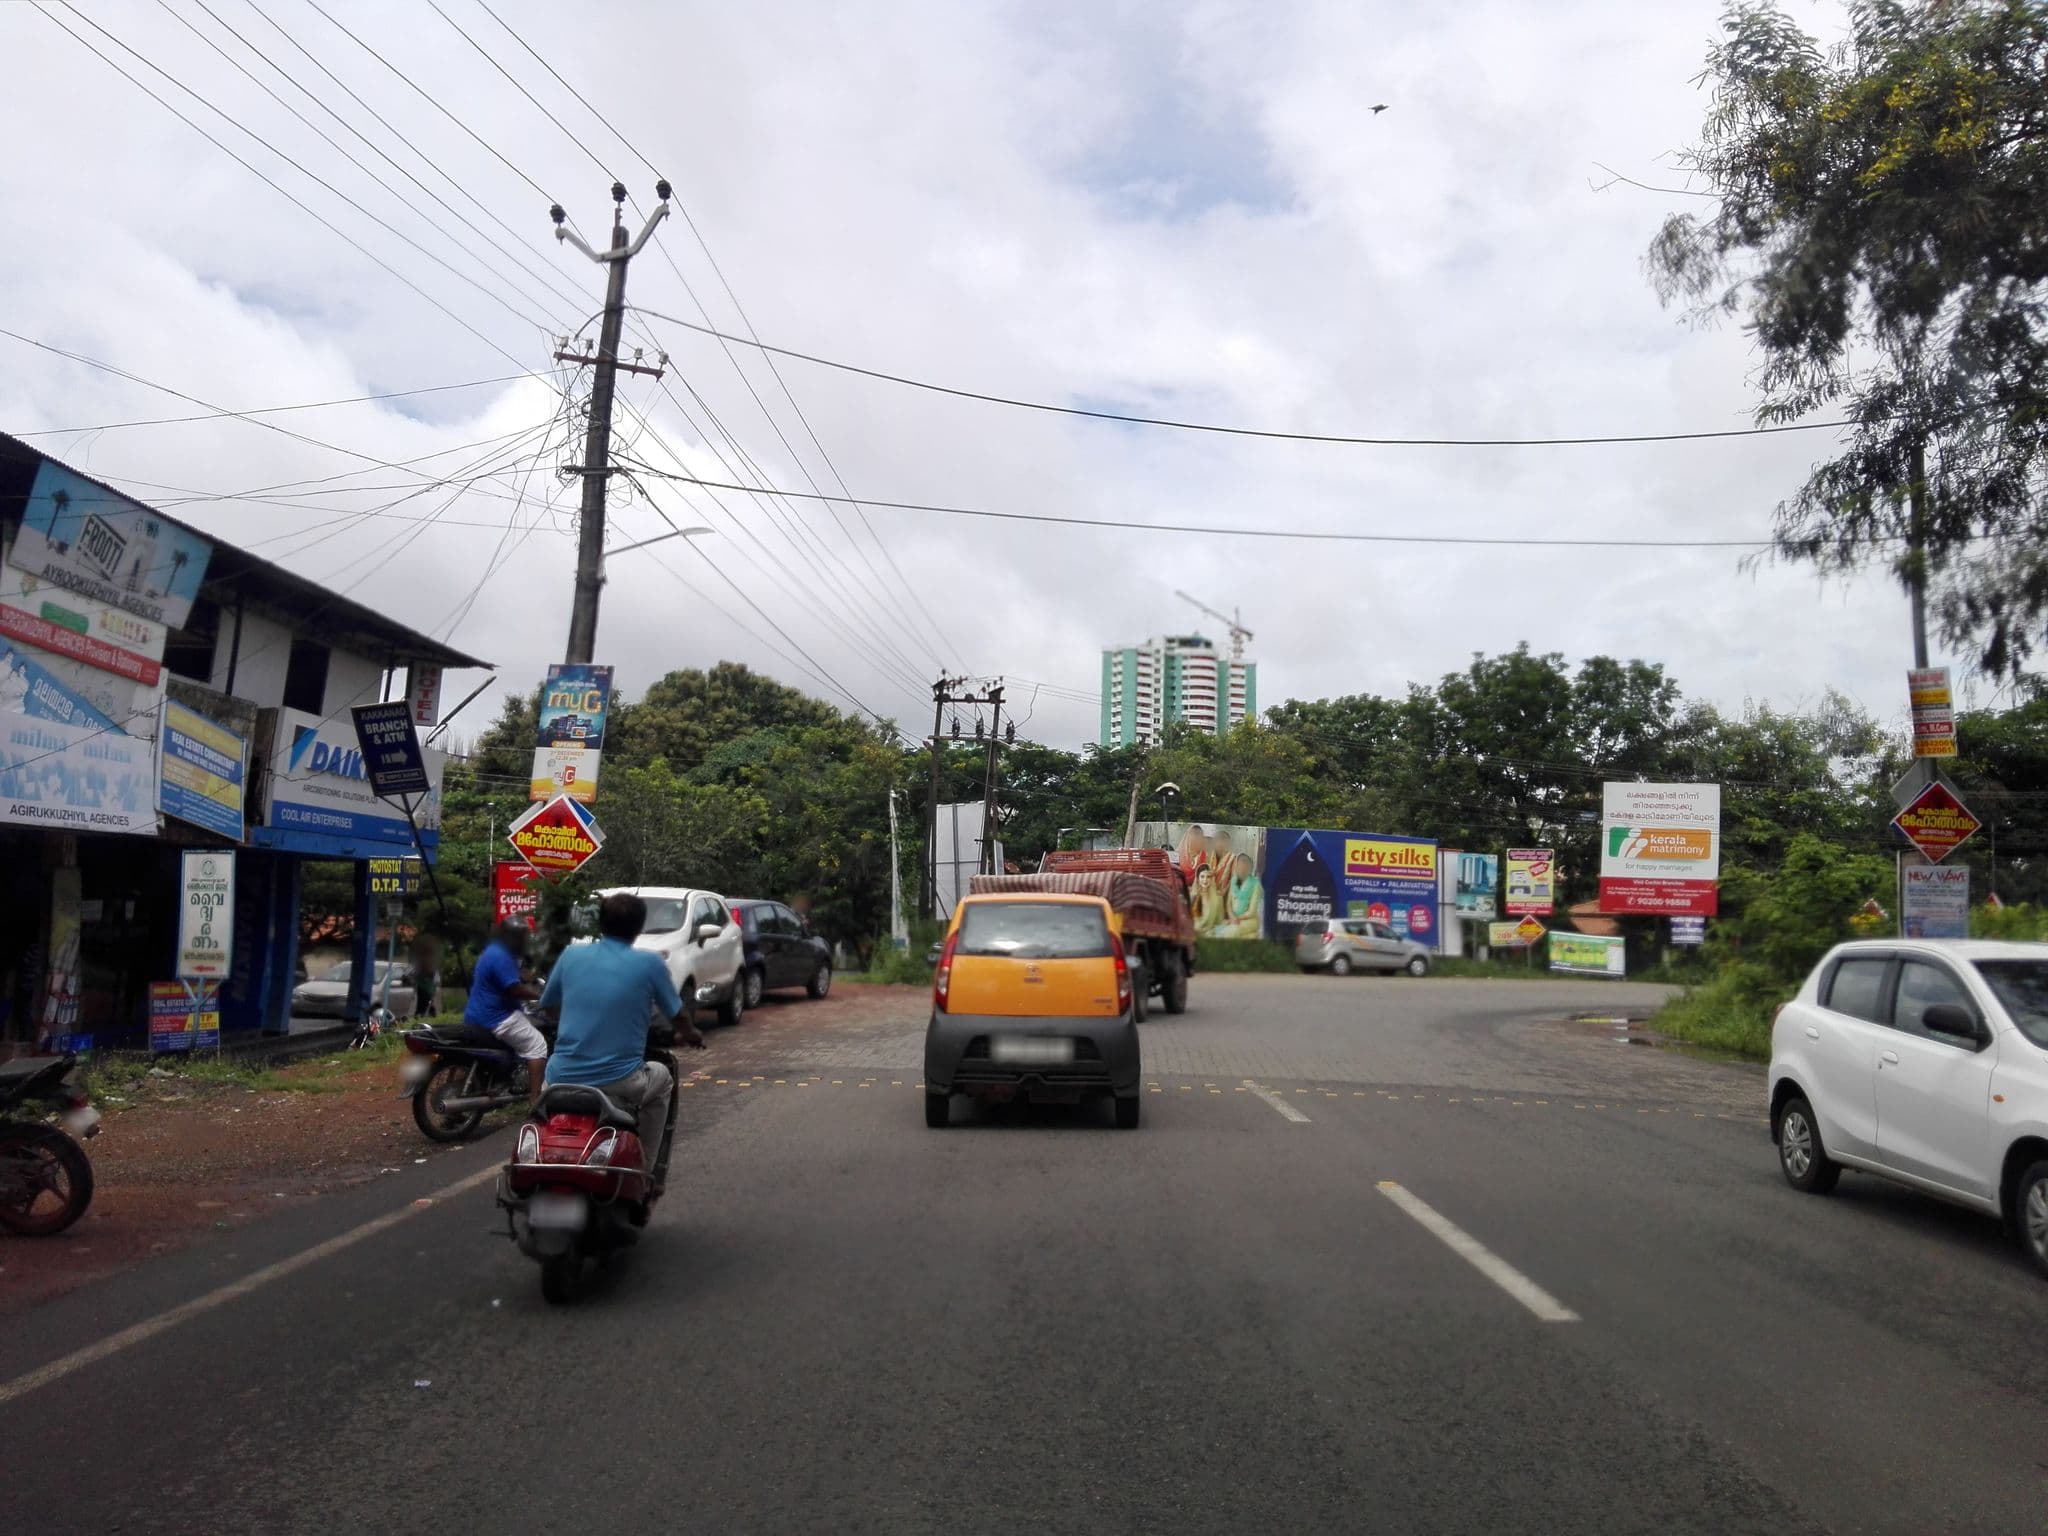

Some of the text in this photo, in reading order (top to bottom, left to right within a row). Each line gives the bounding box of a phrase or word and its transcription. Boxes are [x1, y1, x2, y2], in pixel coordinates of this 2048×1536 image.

[80, 517, 124, 574] FROOTI
[417, 664, 437, 721] HOTEL
[365, 719, 408, 734] BRANCH
[373, 731, 406, 744] & ATM
[89, 814, 130, 827] AGENCIES
[281, 808, 353, 829] COOL AIR ENTERPRISES
[1650, 834, 1686, 845] kerala
[1650, 844, 1704, 856] matrimony
[1351, 847, 1430, 868] city silks
[369, 859, 402, 873] PHOTOSTAT
[1636, 863, 1657, 873] happy
[1277, 899, 1331, 913] Shopping
